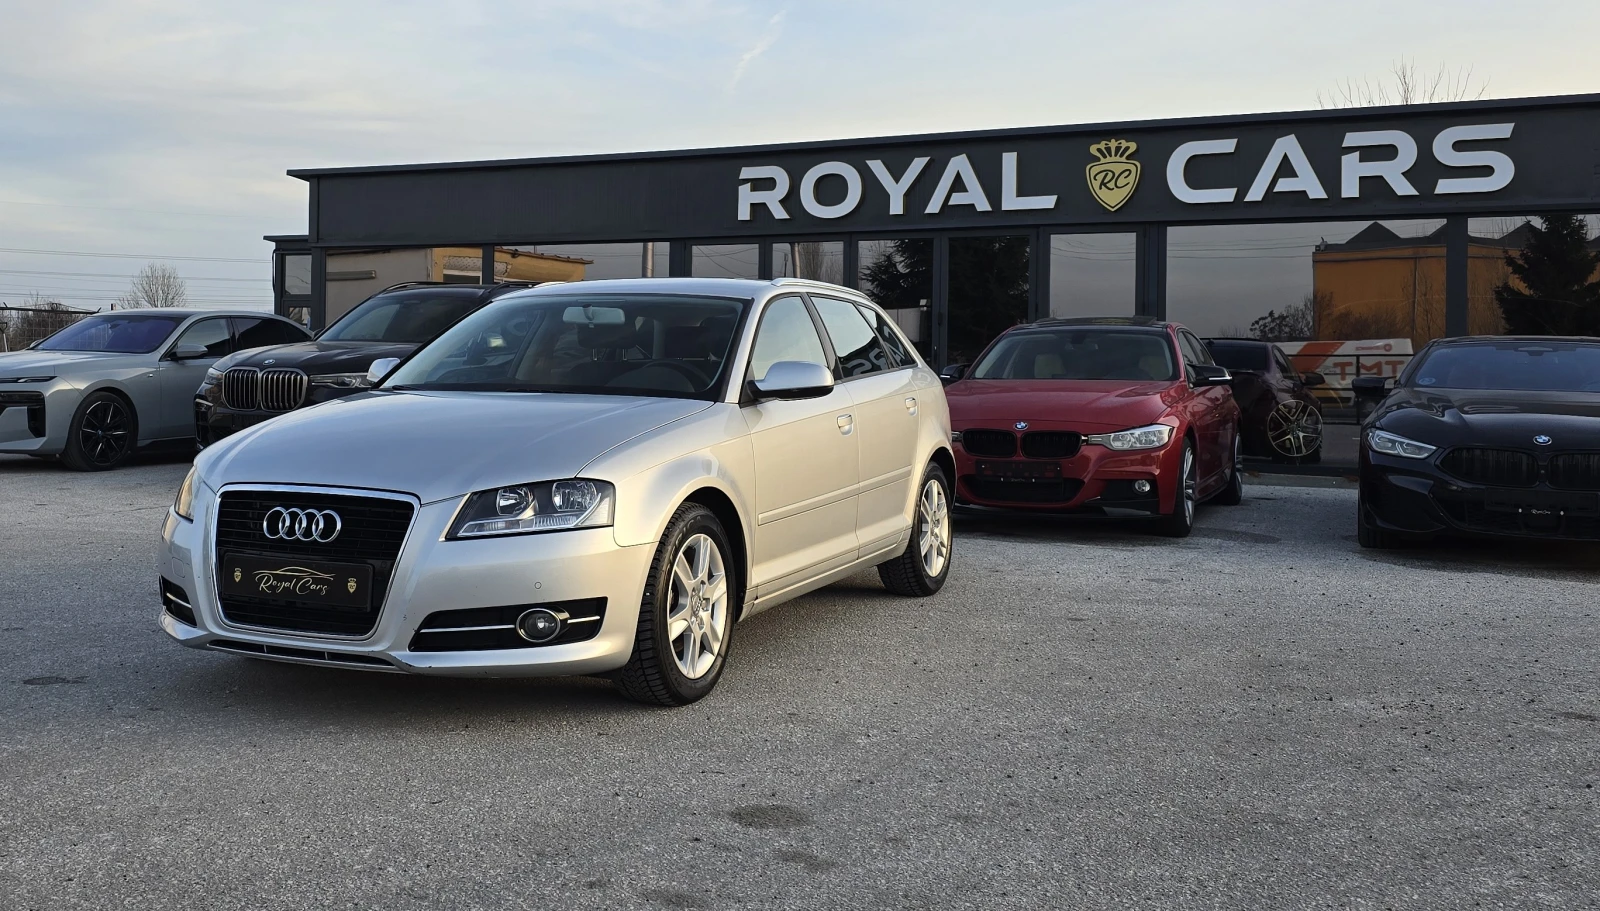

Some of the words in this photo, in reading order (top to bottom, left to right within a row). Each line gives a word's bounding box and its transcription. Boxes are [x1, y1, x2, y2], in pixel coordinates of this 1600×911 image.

[737, 152, 1059, 221] ROYAL
[1166, 122, 1516, 204] CARS
[1093, 168, 1132, 191] RC
[255, 573, 297, 593] Royal
[296, 578, 329, 595] Cars
